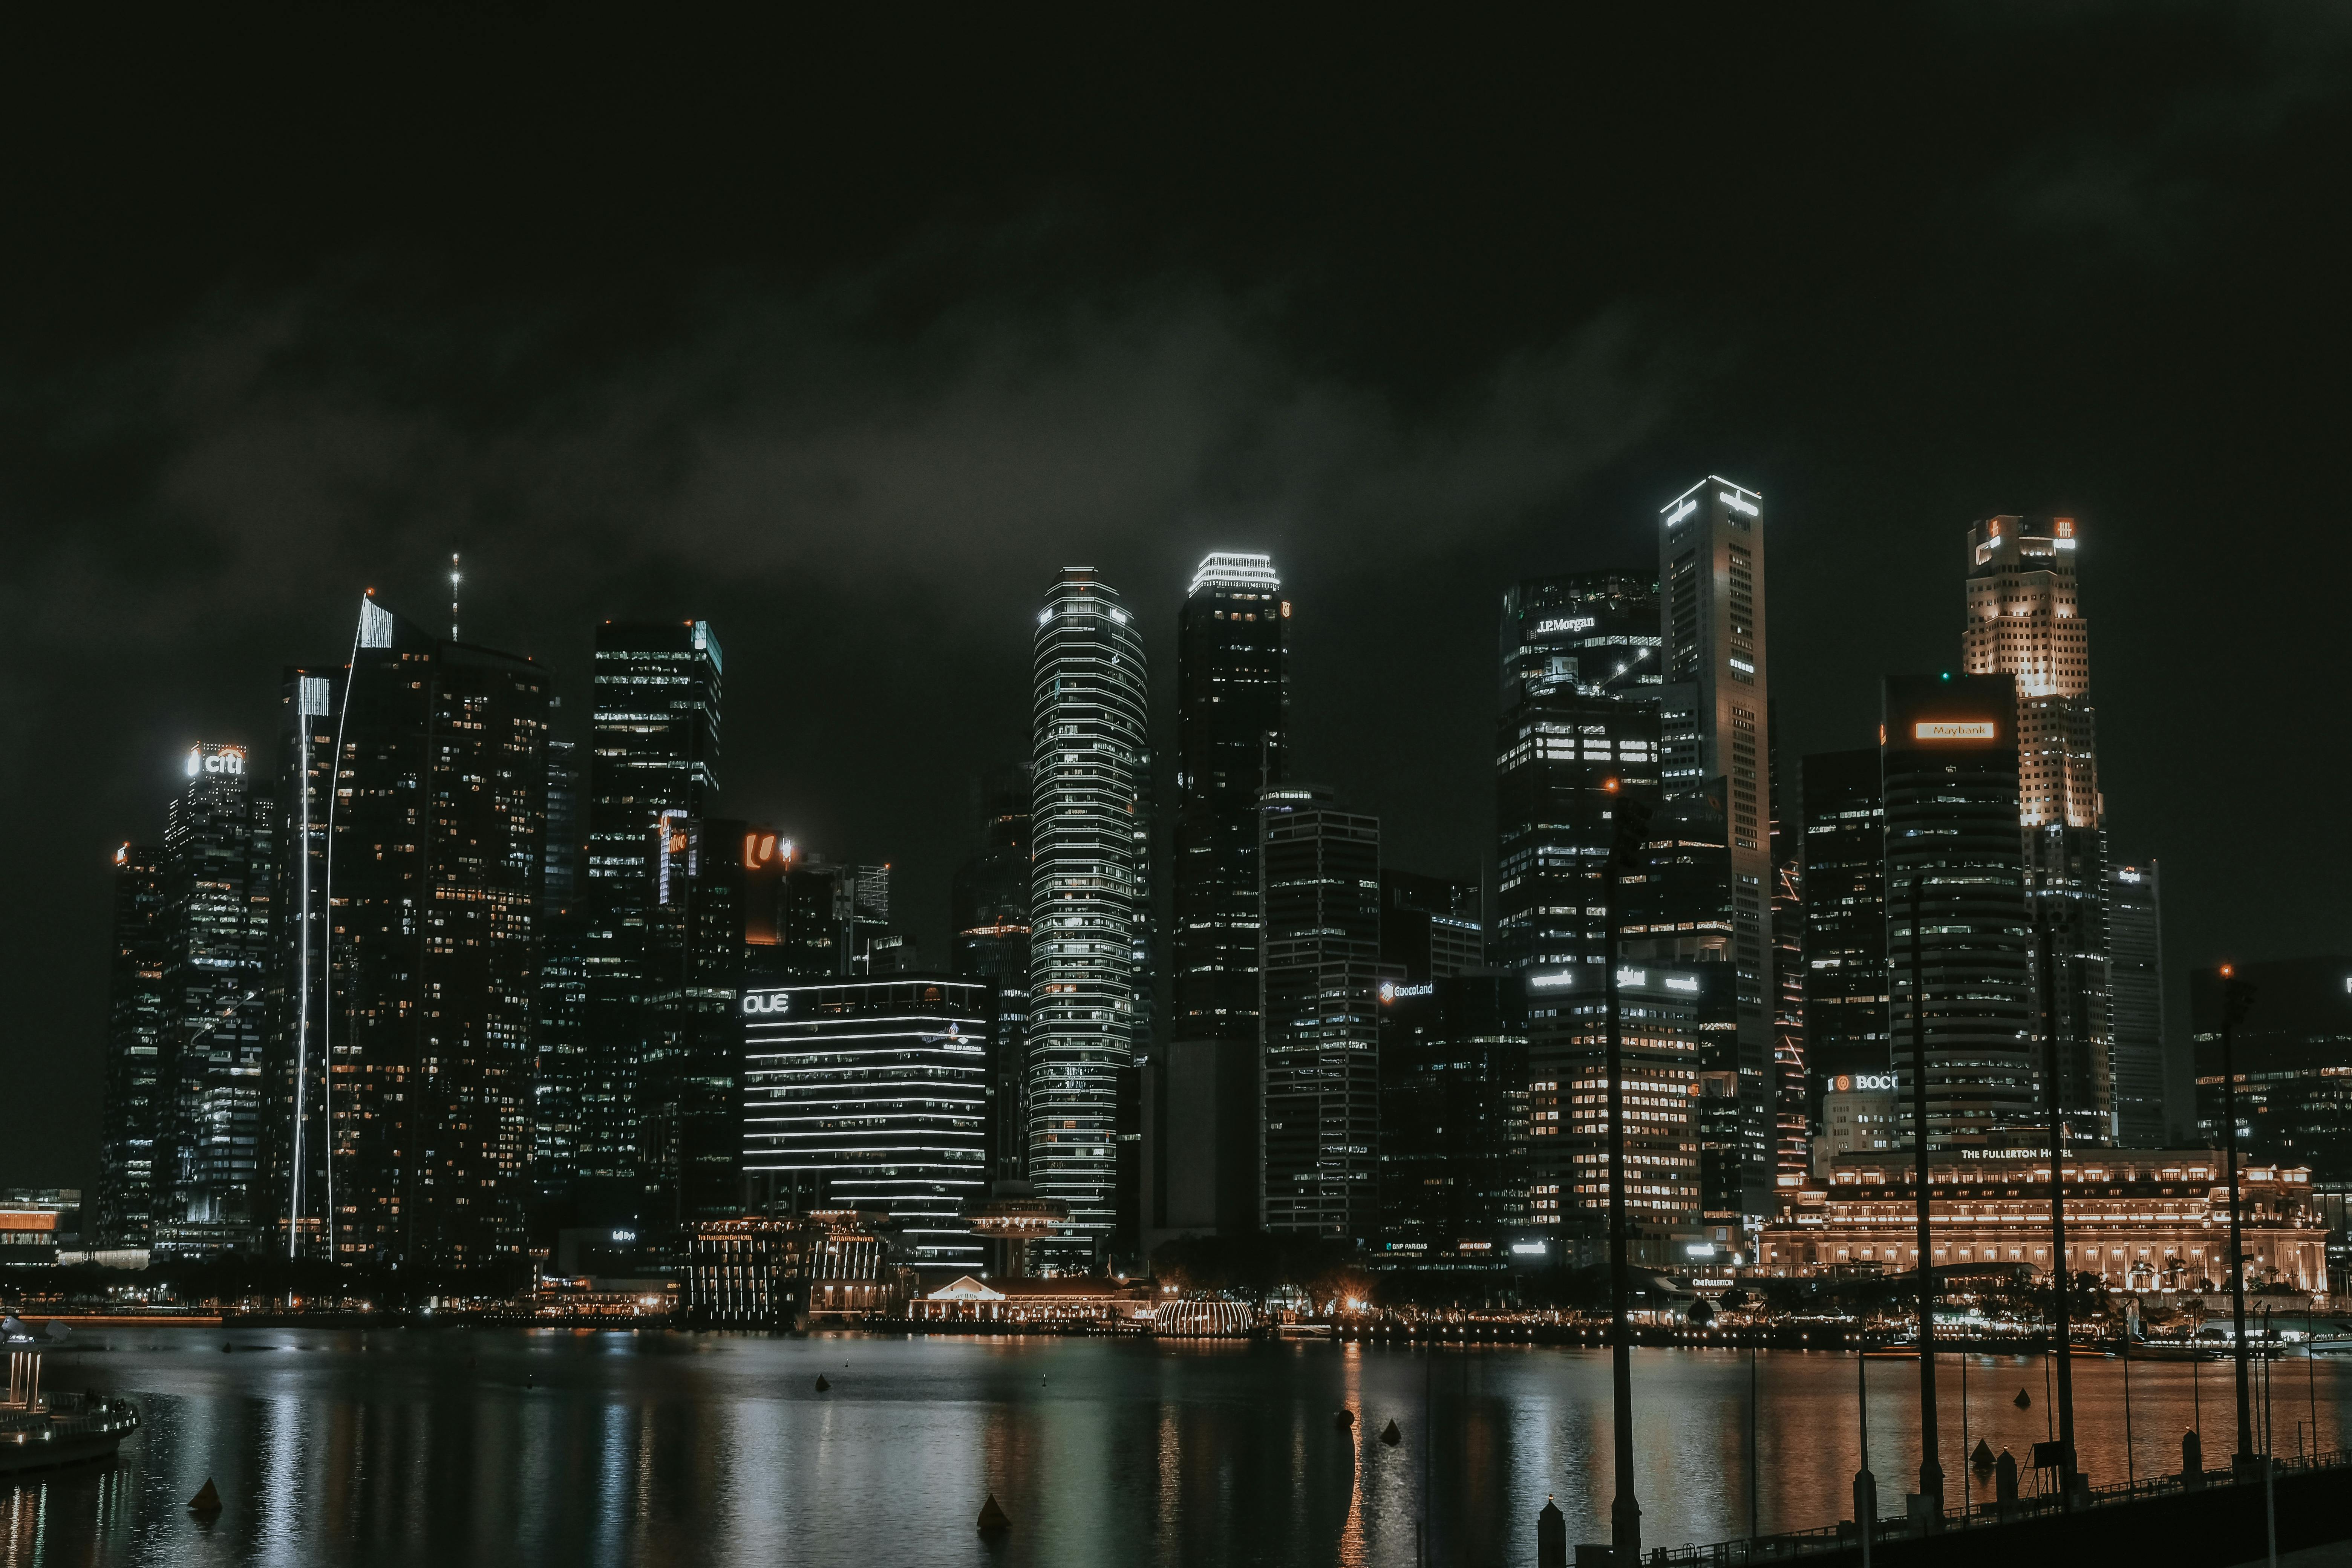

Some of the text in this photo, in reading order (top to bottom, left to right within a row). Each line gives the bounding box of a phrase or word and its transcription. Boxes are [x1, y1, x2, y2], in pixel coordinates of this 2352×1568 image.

[1537, 617, 1594, 632] J.P.Morgan
[1934, 726, 1985, 736] Maybank
[205, 753, 242, 774] citi
[744, 994, 789, 1013] OUE
[1856, 1076, 1891, 1089] BOC
[1962, 1150, 1979, 1158] THE
[1983, 1150, 2037, 1158] FULLERTON
